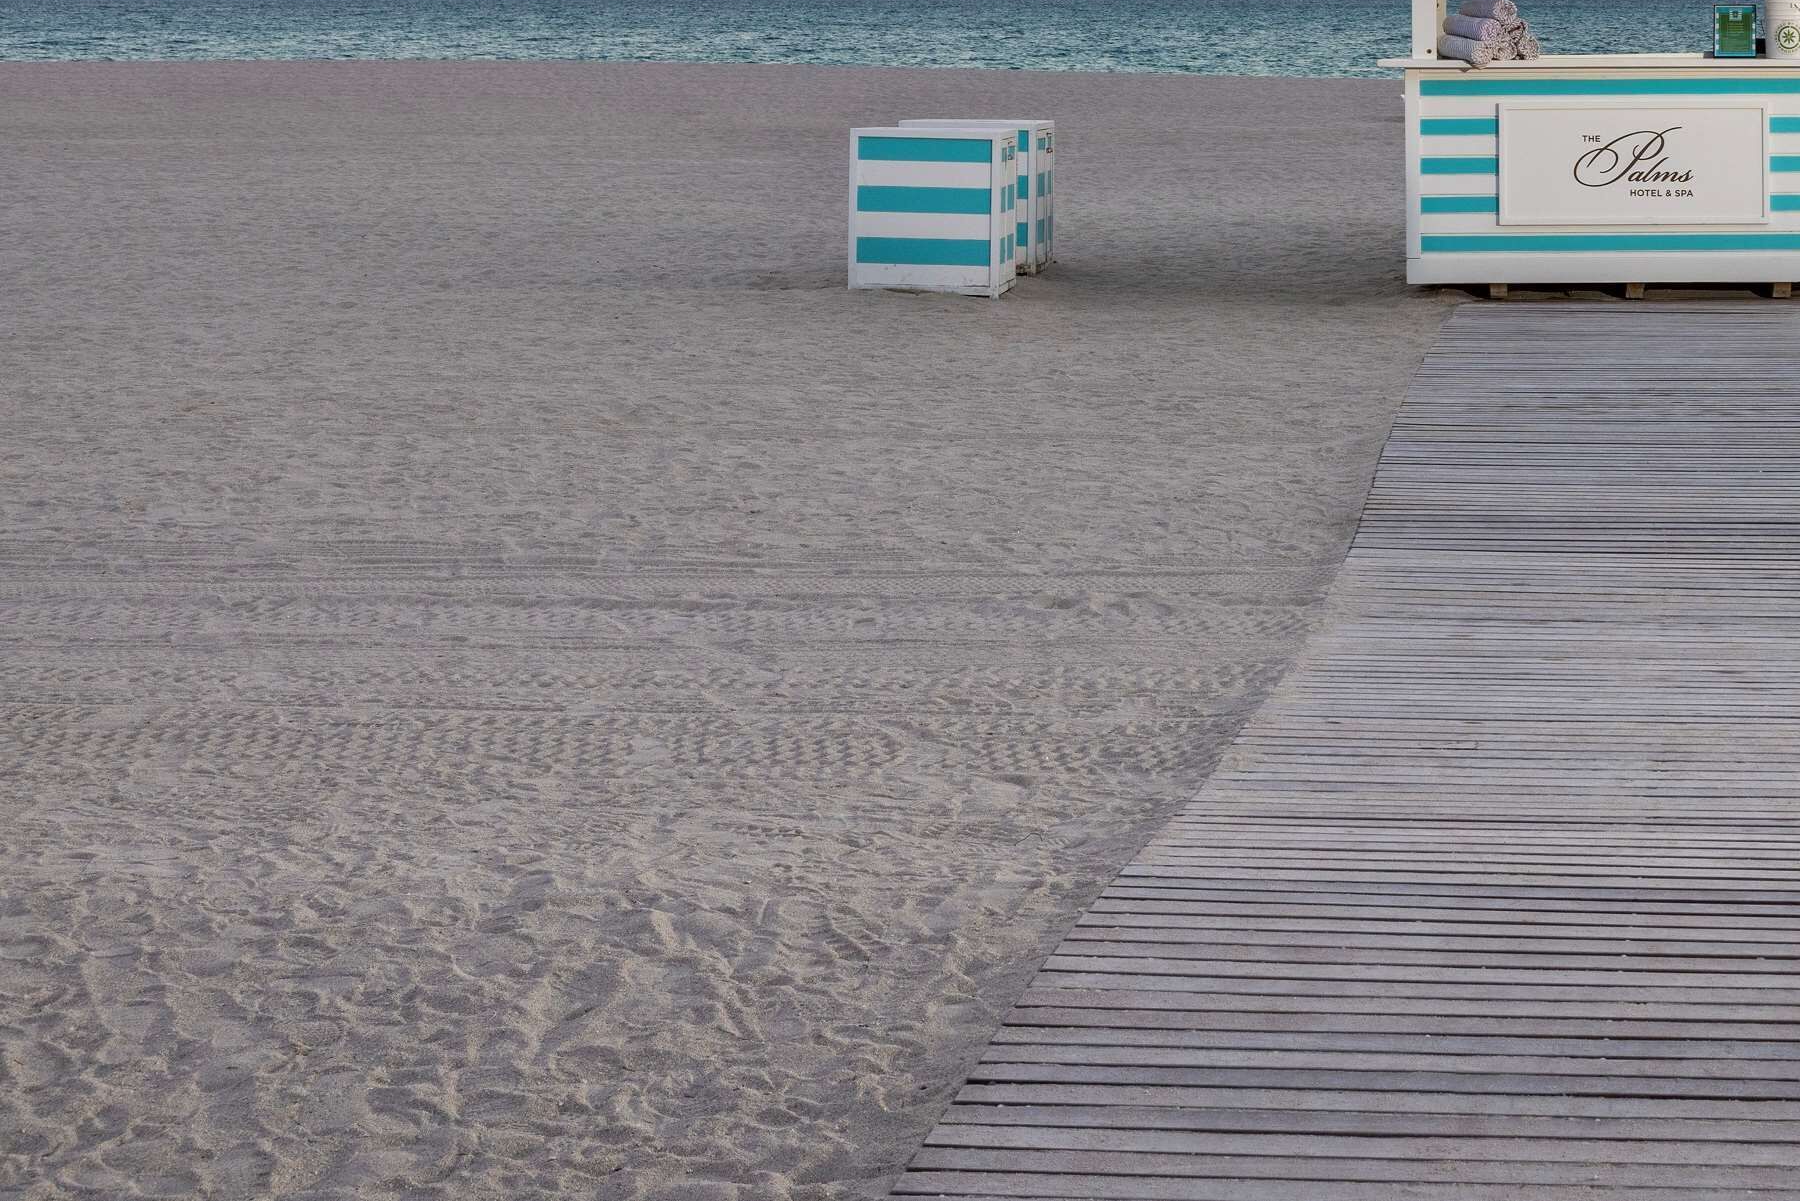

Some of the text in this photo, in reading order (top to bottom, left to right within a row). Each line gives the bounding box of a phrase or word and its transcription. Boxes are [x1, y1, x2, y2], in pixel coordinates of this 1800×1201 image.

[1582, 135, 1601, 143] THE
[1574, 127, 1694, 187] Palms
[1630, 189, 1694, 197] HOTEL & SPA
